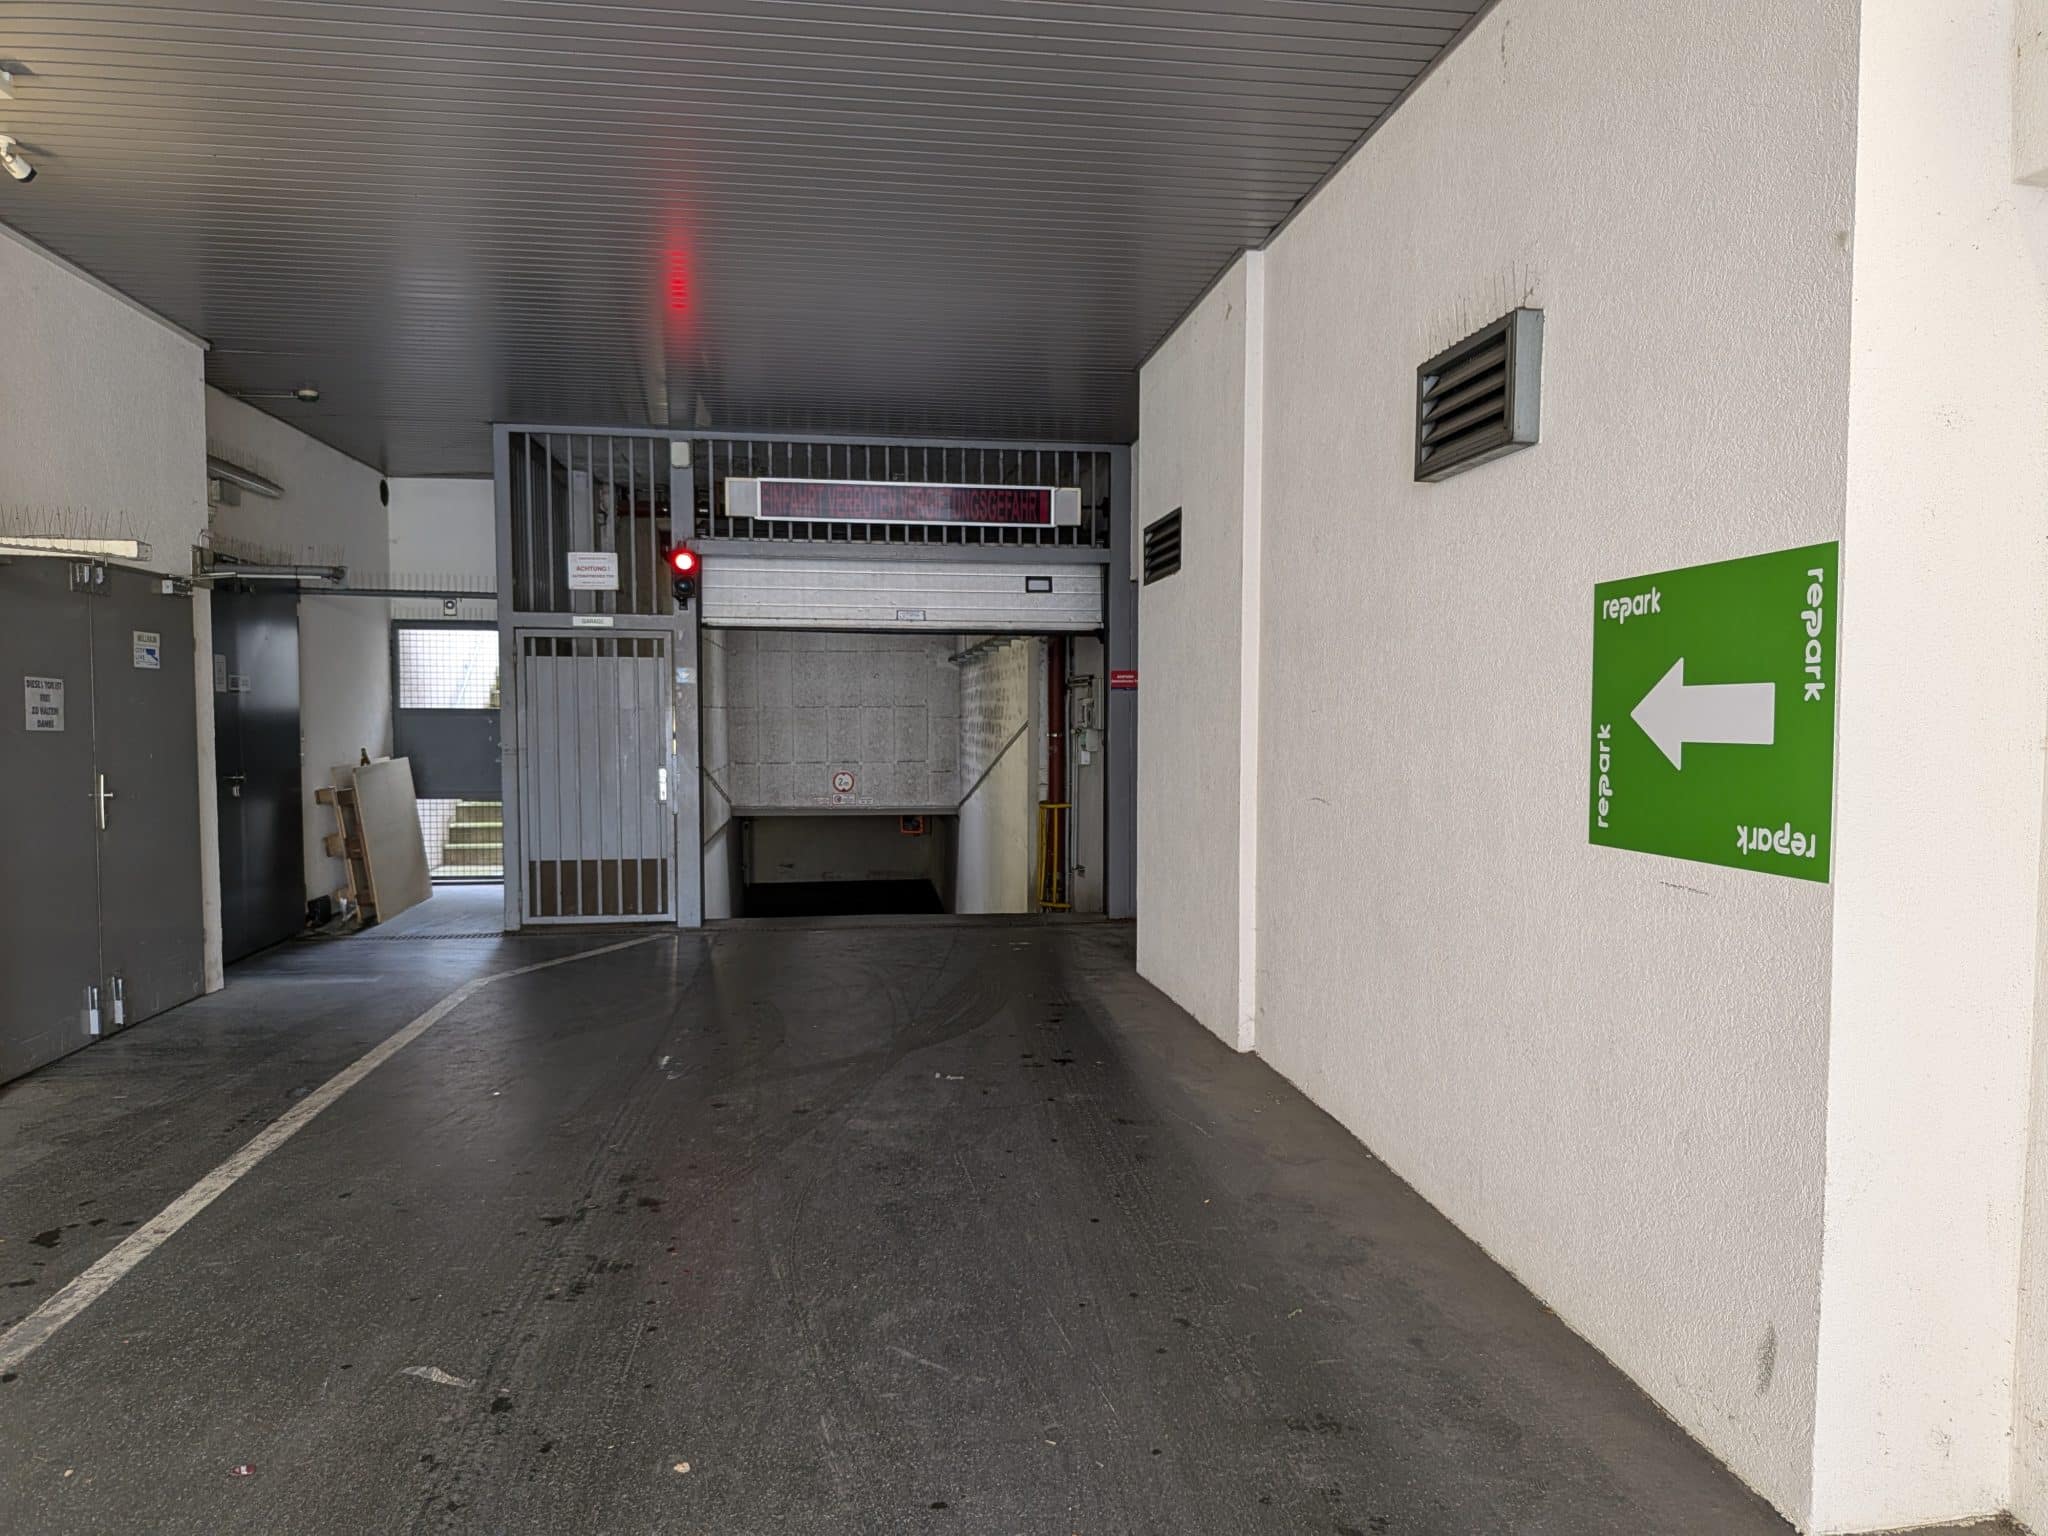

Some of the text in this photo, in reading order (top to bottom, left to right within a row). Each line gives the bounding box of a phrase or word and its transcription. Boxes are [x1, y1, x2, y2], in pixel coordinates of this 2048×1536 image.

[762, 482, 824, 517] EINFAHRT
[828, 485, 897, 518] VERBOTEN
[1603, 587, 1661, 624] repark
[1801, 568, 1825, 701] repark
[1597, 724, 1613, 828] repark
[1737, 822, 1816, 858] repark
